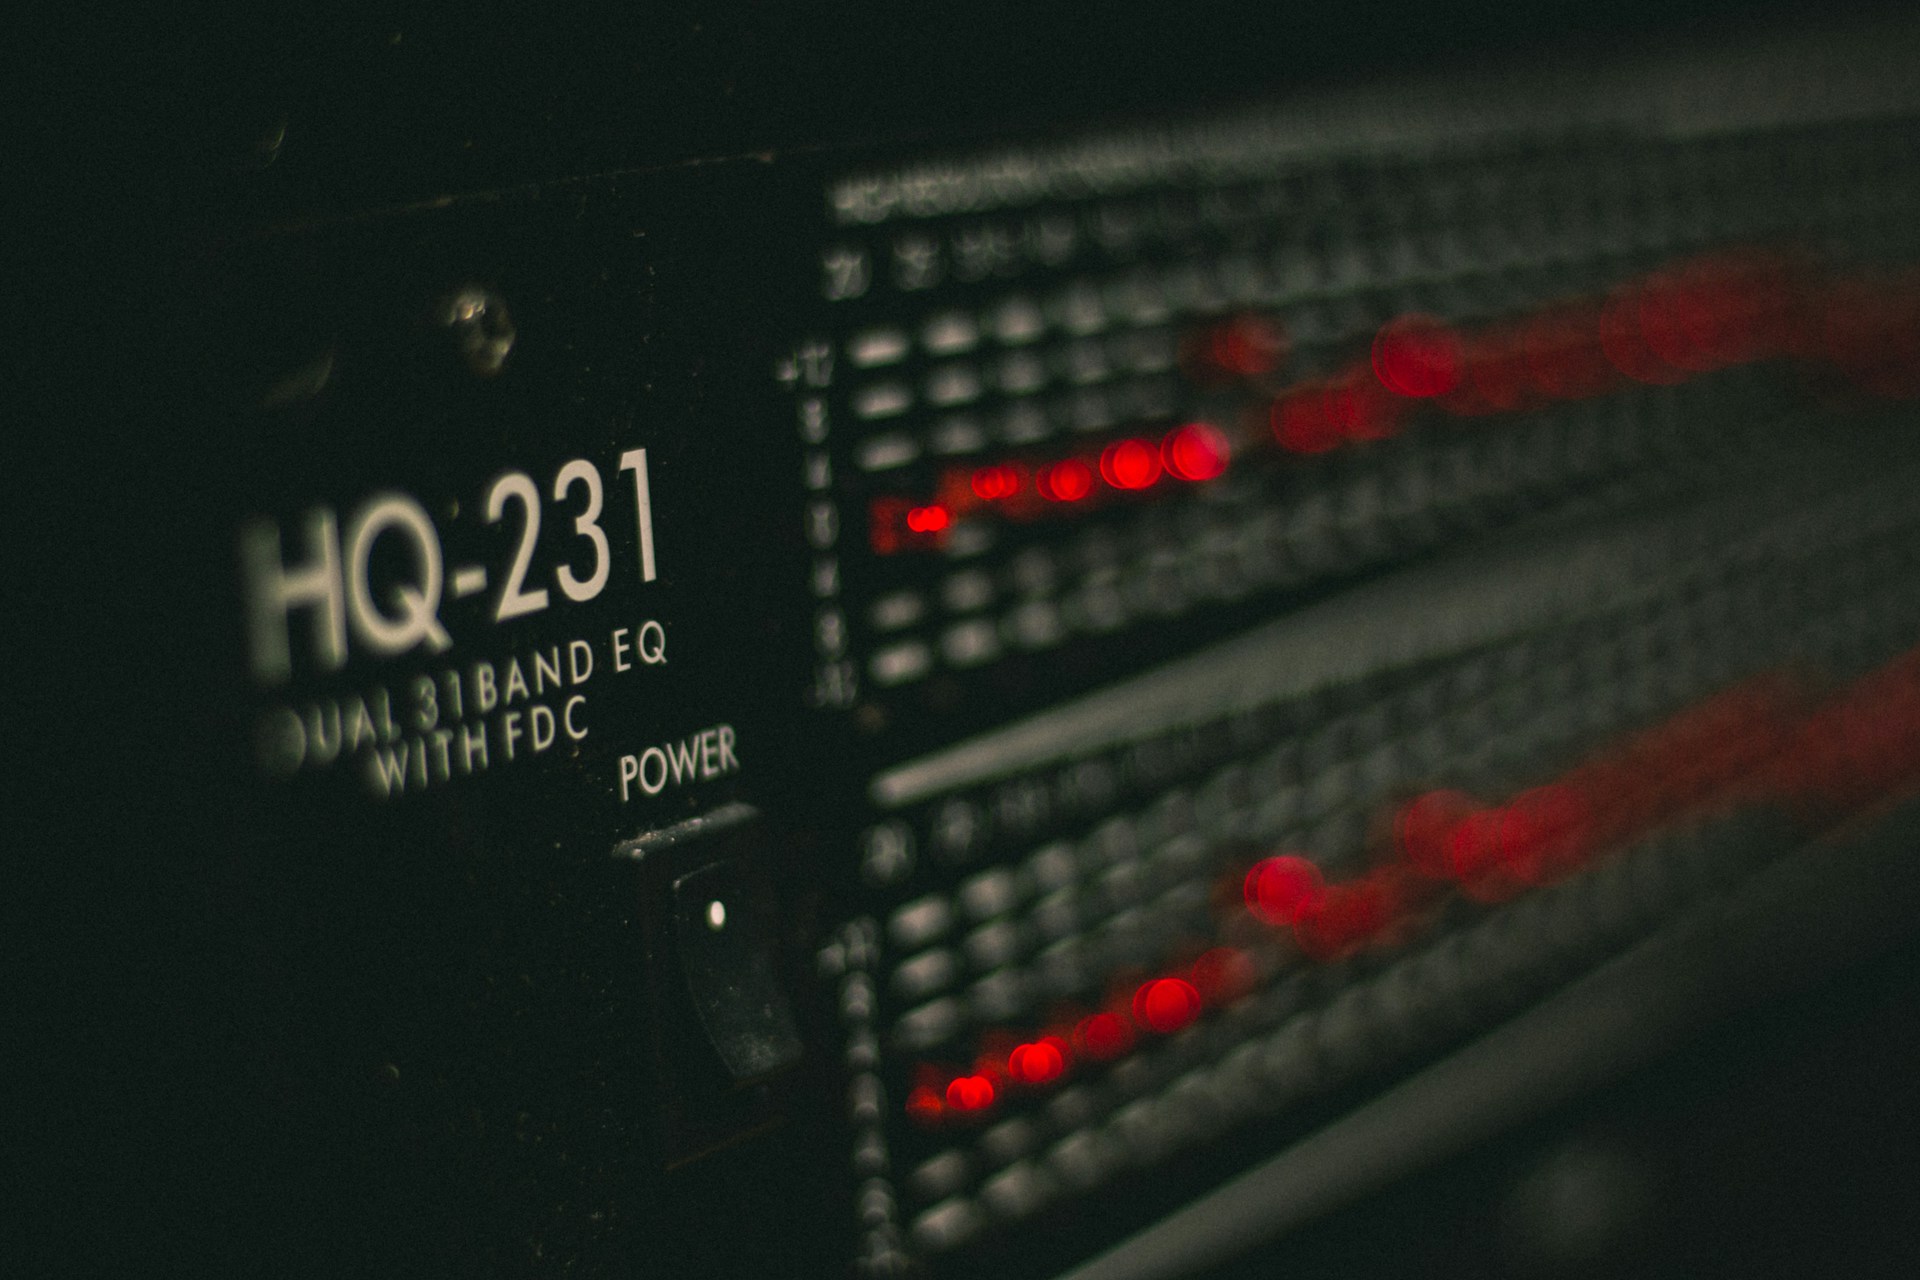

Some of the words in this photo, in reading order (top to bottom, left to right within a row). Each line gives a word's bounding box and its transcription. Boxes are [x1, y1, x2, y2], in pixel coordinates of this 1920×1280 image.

[238, 447, 657, 682] HQ-231
[412, 672, 463, 733] 31
[473, 639, 594, 713] BAND
[612, 620, 668, 672] EQ
[364, 719, 489, 799] WITH
[505, 695, 589, 760] FDC
[619, 724, 740, 802] POWER
